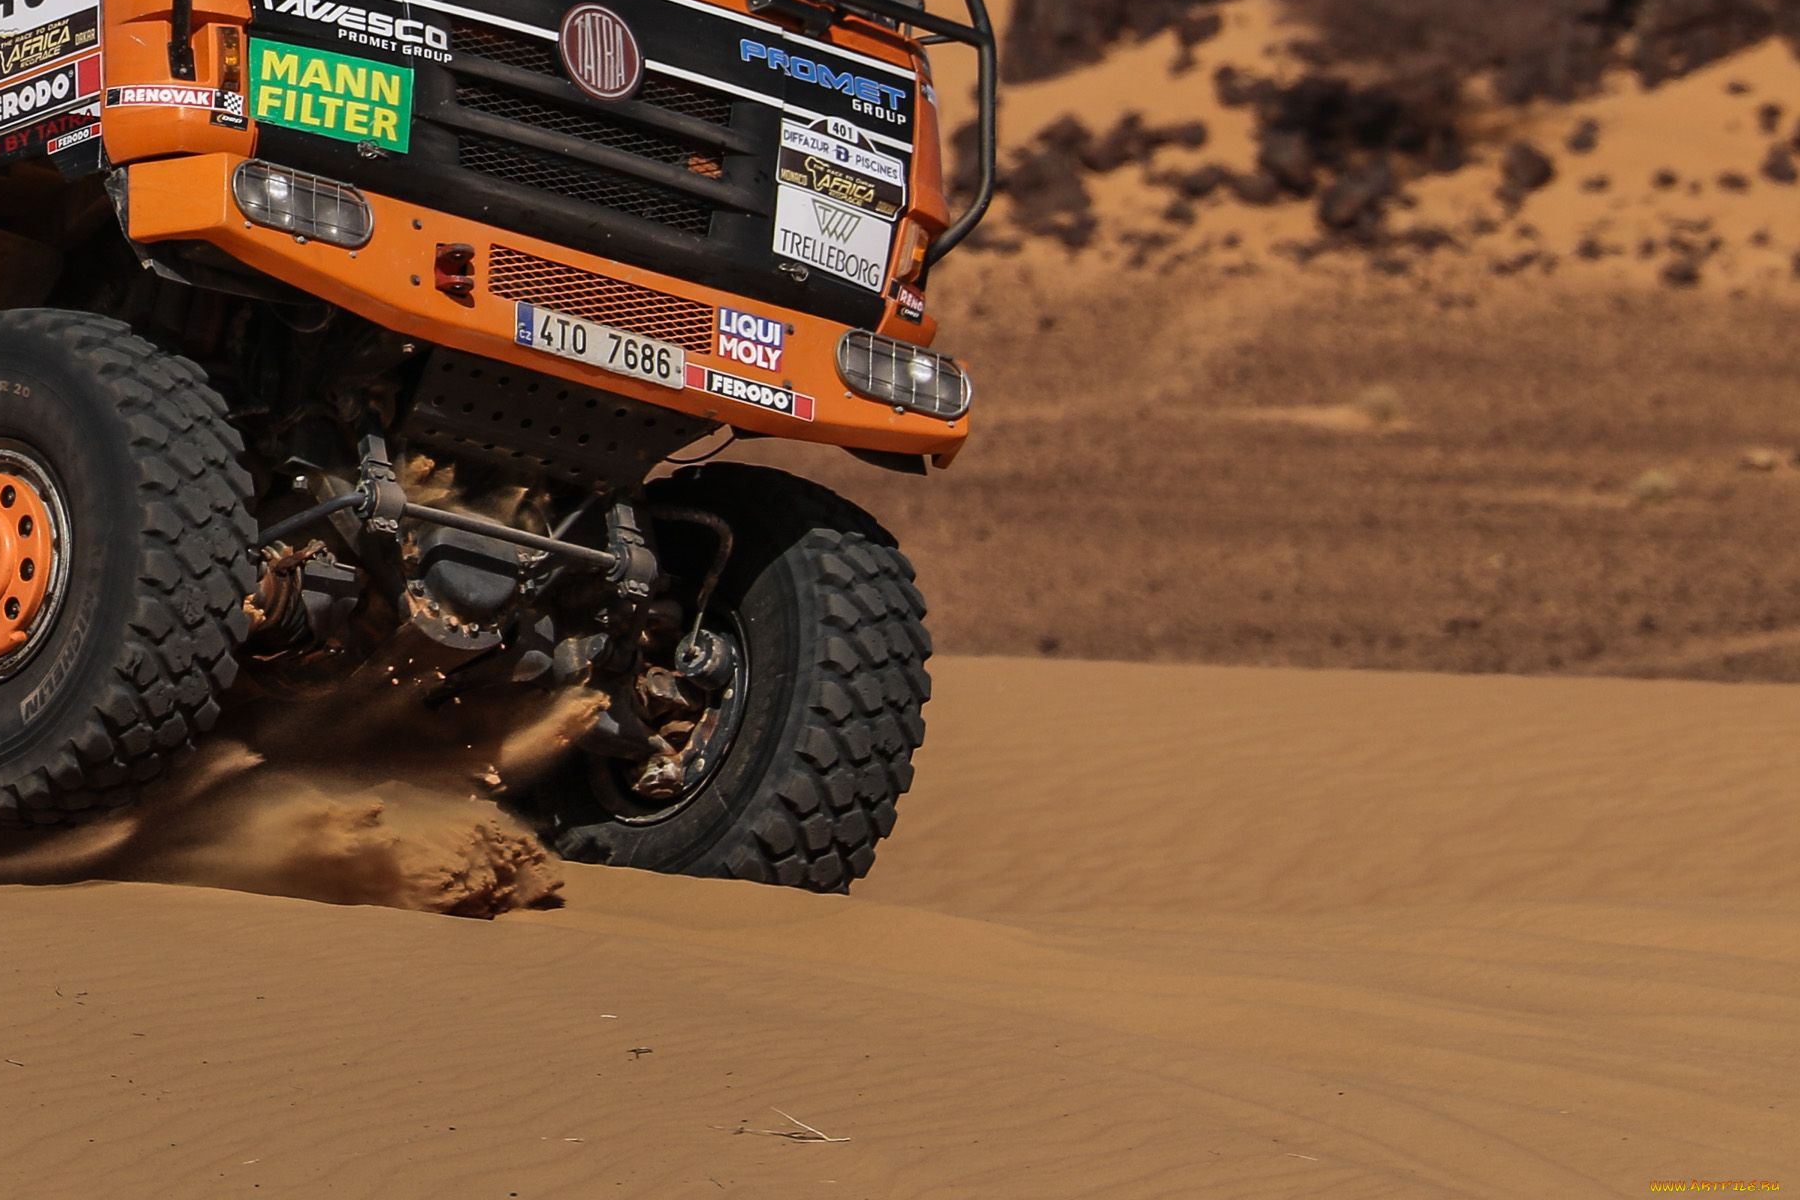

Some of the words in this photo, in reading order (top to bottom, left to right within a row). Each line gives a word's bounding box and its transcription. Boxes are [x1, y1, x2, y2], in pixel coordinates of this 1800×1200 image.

[6, 25, 71, 68] AFRICA
[338, 28, 397, 53] PROMET
[402, 44, 453, 64] GROUP
[574, 12, 626, 91] TATRA
[261, 49, 401, 107] MANN
[739, 37, 907, 111] PROMET
[123, 88, 210, 105] RENOVAK
[256, 85, 399, 142] FILTER
[852, 98, 908, 126] GROUP
[4, 129, 31, 152] BY
[37, 107, 95, 140] TATRA
[57, 128, 90, 149] FERODO
[832, 121, 853, 140] 401
[783, 129, 830, 153] DIFFAZUR
[855, 154, 898, 179] PISCINES
[816, 174, 876, 203] AFRICA
[780, 228, 880, 287] TRELLEBORG
[718, 308, 783, 346] LIQUI
[518, 328, 532, 342] CZ
[607, 332, 671, 379] 7686
[718, 333, 783, 371] MOLY
[711, 373, 789, 410] FERODO
